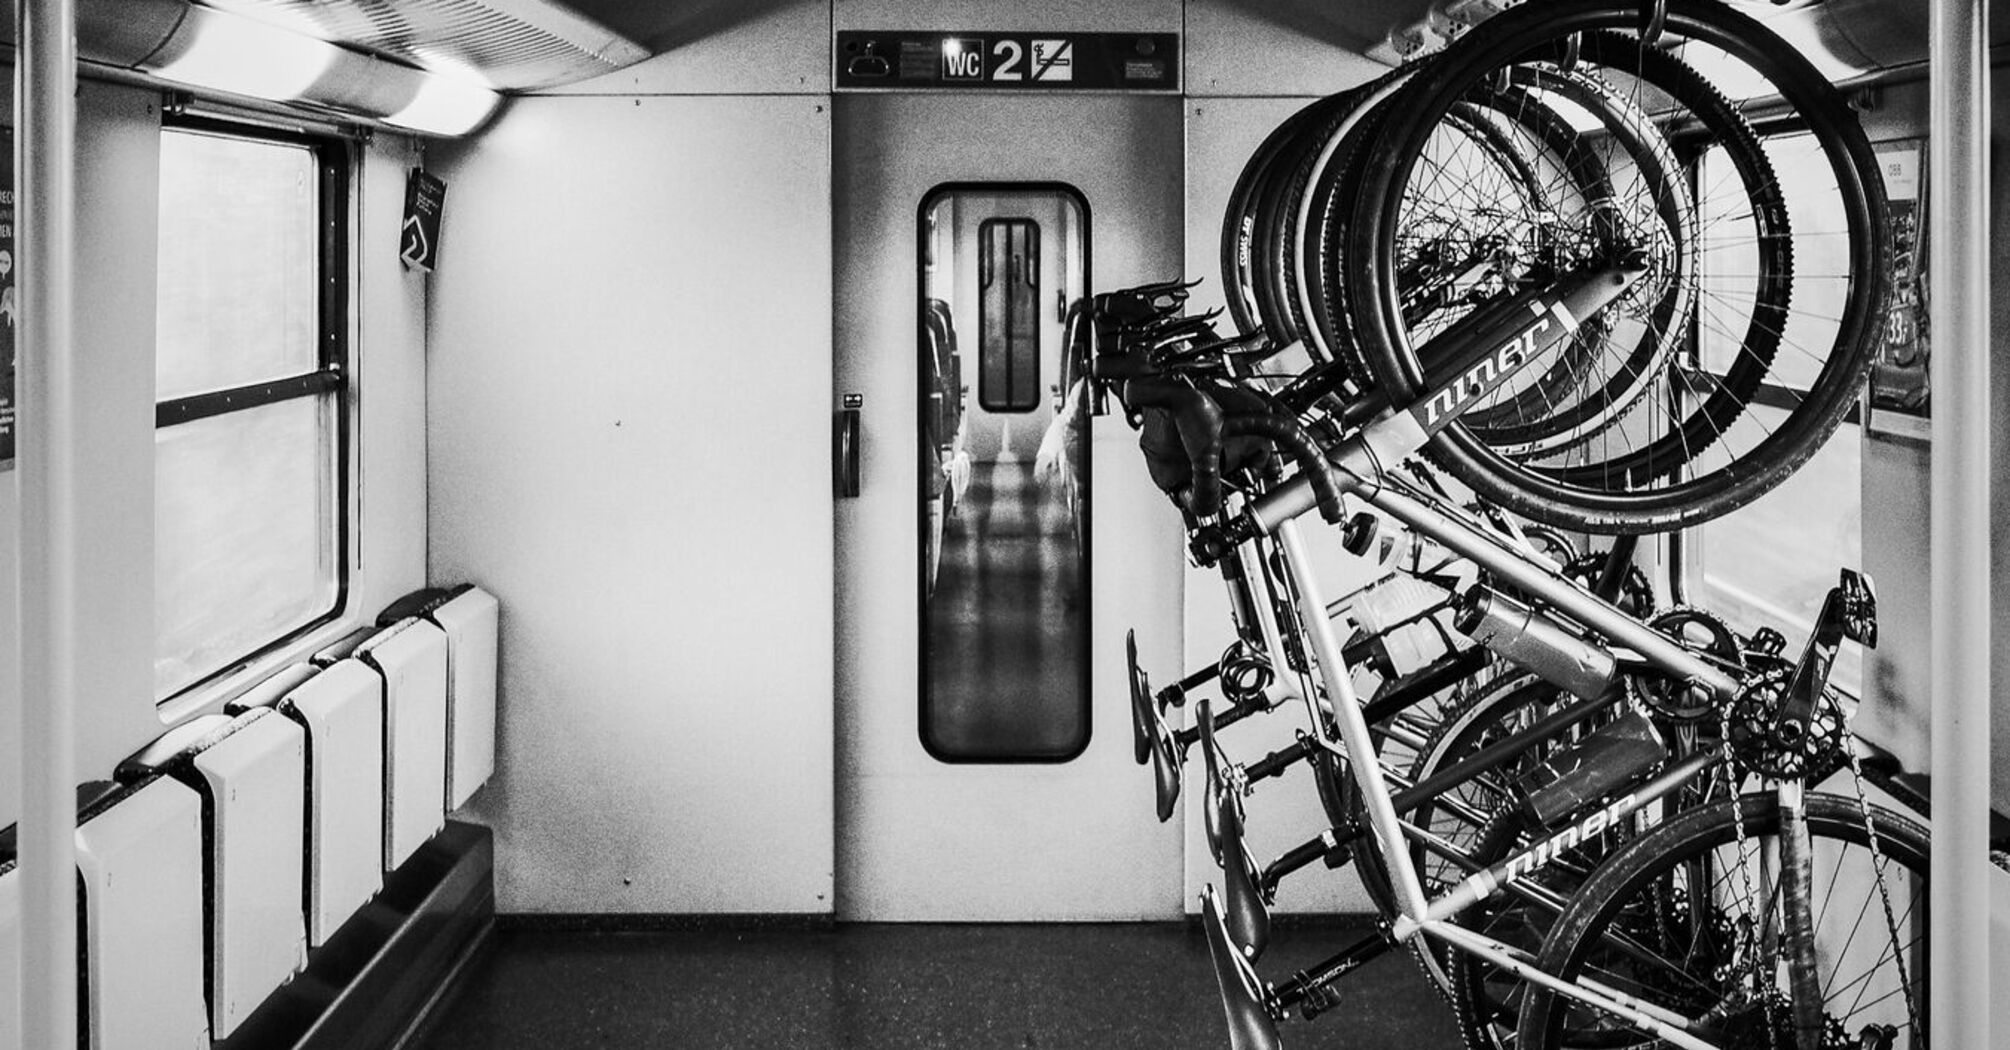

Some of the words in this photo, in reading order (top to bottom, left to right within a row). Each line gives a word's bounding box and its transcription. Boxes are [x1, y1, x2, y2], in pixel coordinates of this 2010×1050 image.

[946, 52, 979, 76] WC
[992, 40, 1023, 81] 2
[1239, 235, 1248, 267] SWISS
[1424, 317, 1549, 427] niner
[1505, 793, 1636, 884] niner
